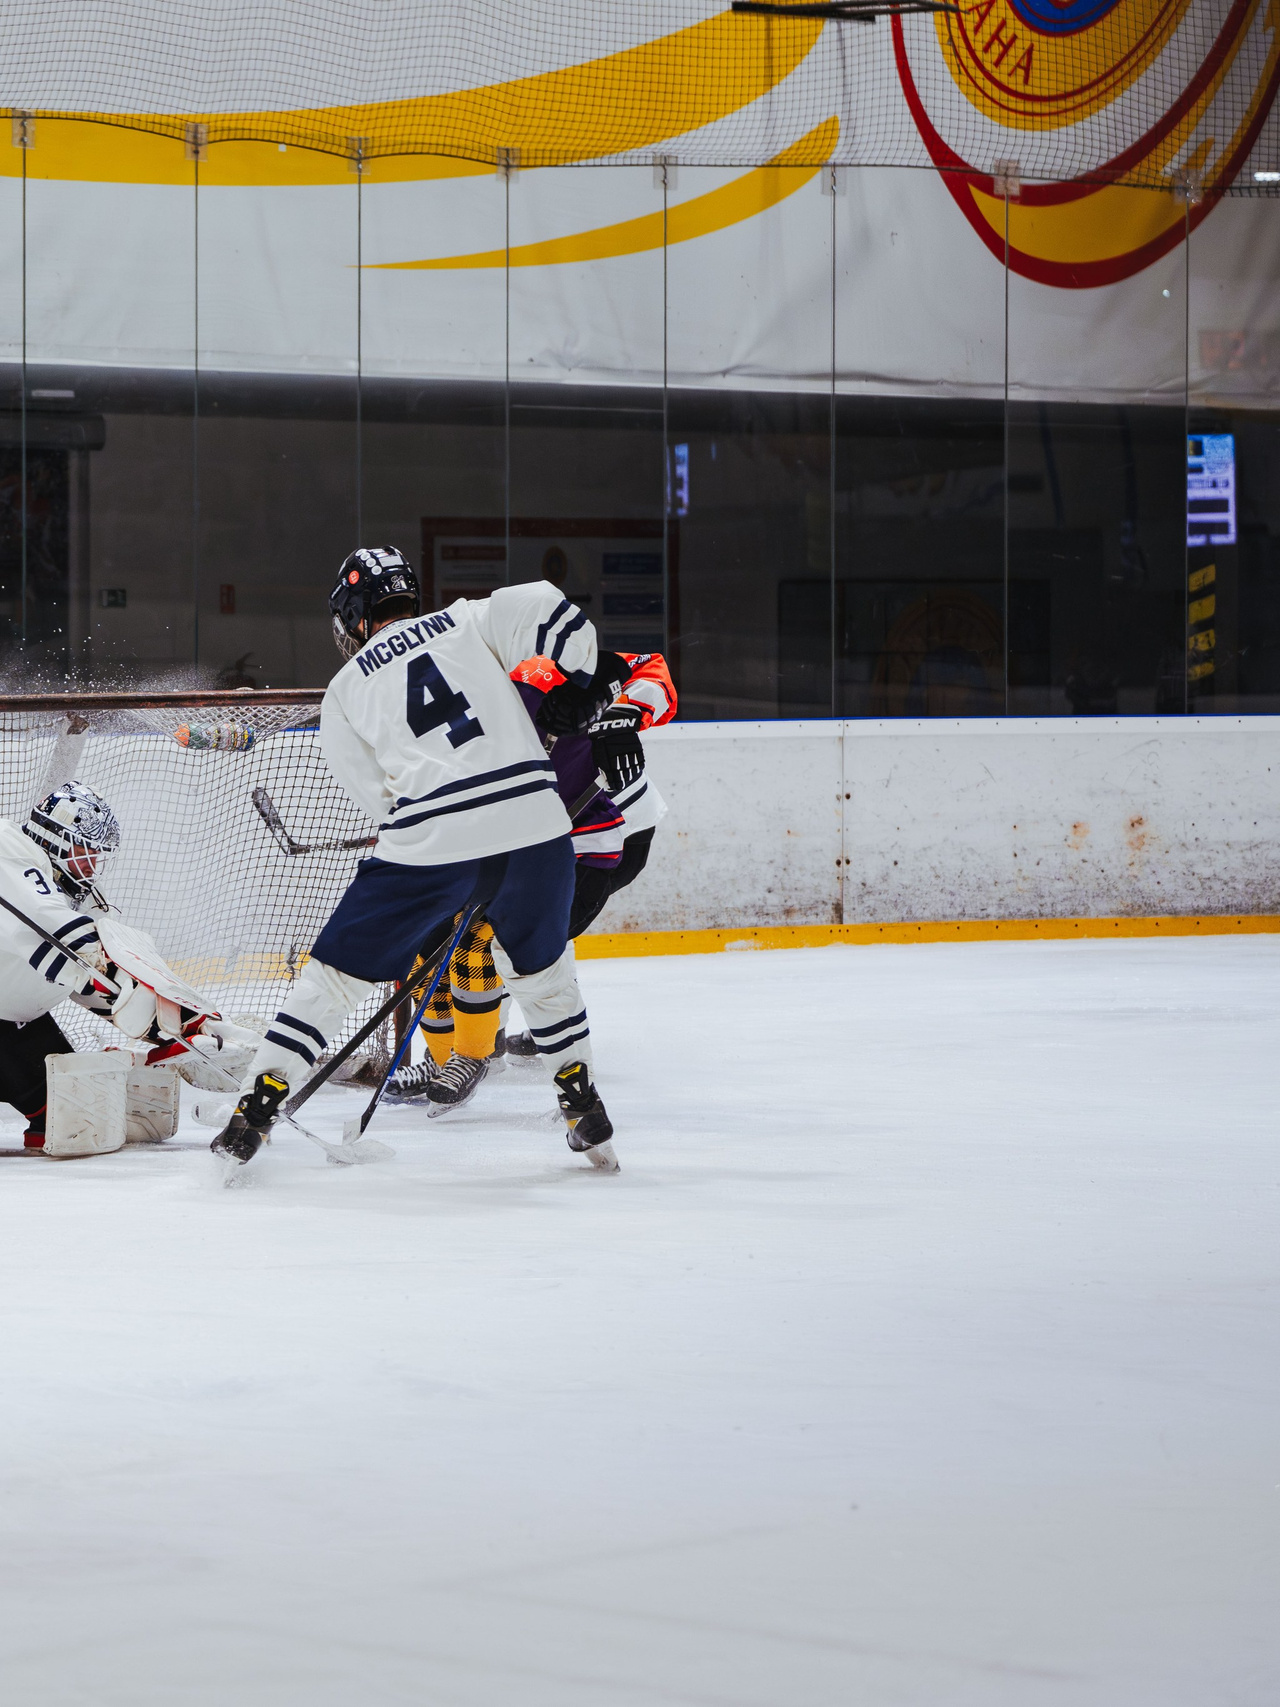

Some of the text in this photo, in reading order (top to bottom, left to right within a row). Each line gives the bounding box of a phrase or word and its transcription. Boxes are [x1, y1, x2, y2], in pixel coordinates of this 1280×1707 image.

[356, 611, 456, 677] MCGLYNN
[406, 651, 485, 749] 4
[23, 867, 62, 895] 3
